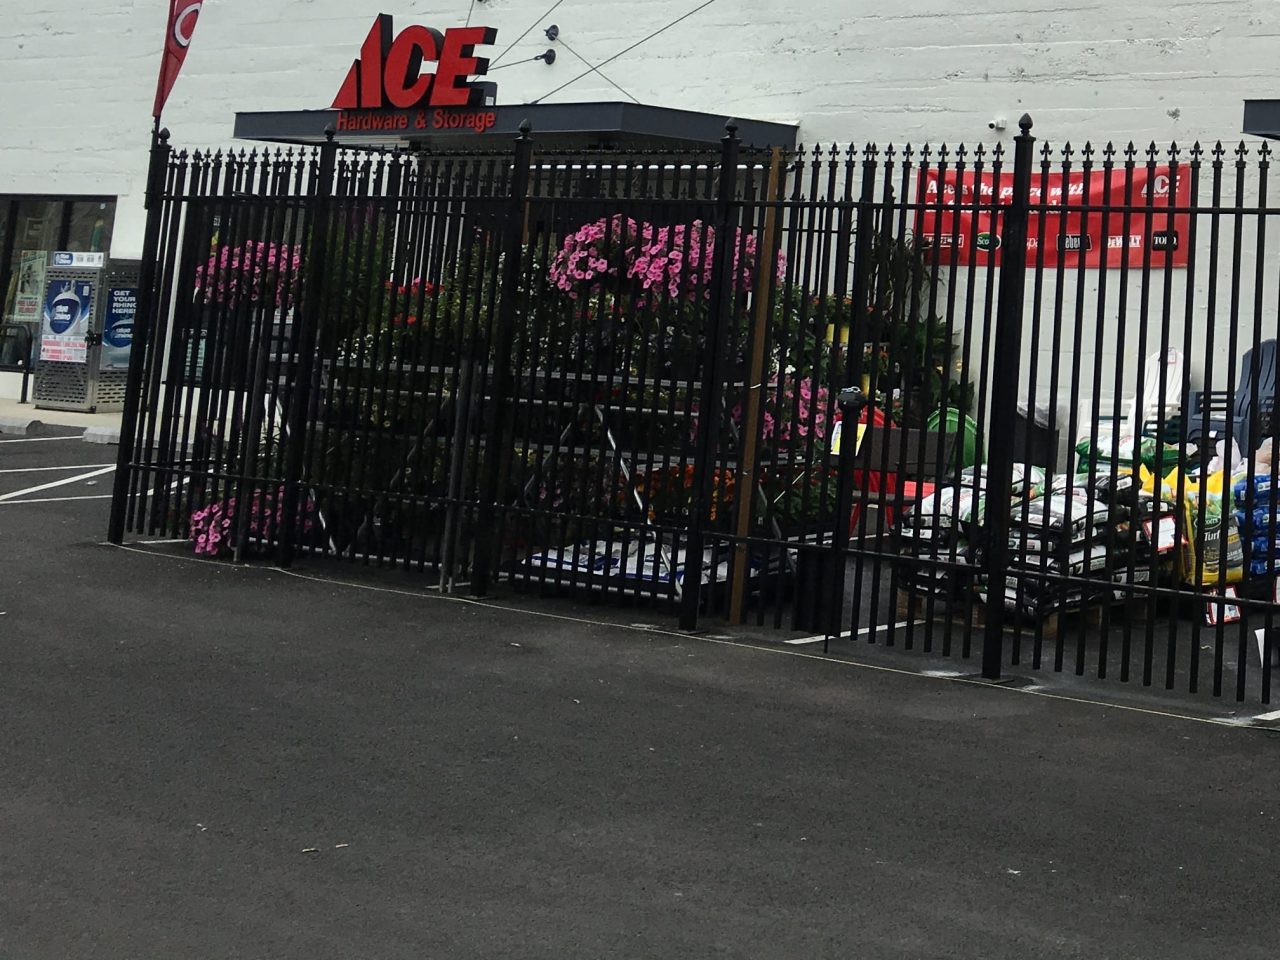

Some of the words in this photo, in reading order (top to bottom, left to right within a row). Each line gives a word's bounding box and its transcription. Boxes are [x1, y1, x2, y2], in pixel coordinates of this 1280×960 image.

[330, 12, 498, 110] ACE
[336, 110, 408, 132] Hardware
[414, 110, 427, 130] &
[432, 108, 497, 134] Storage
